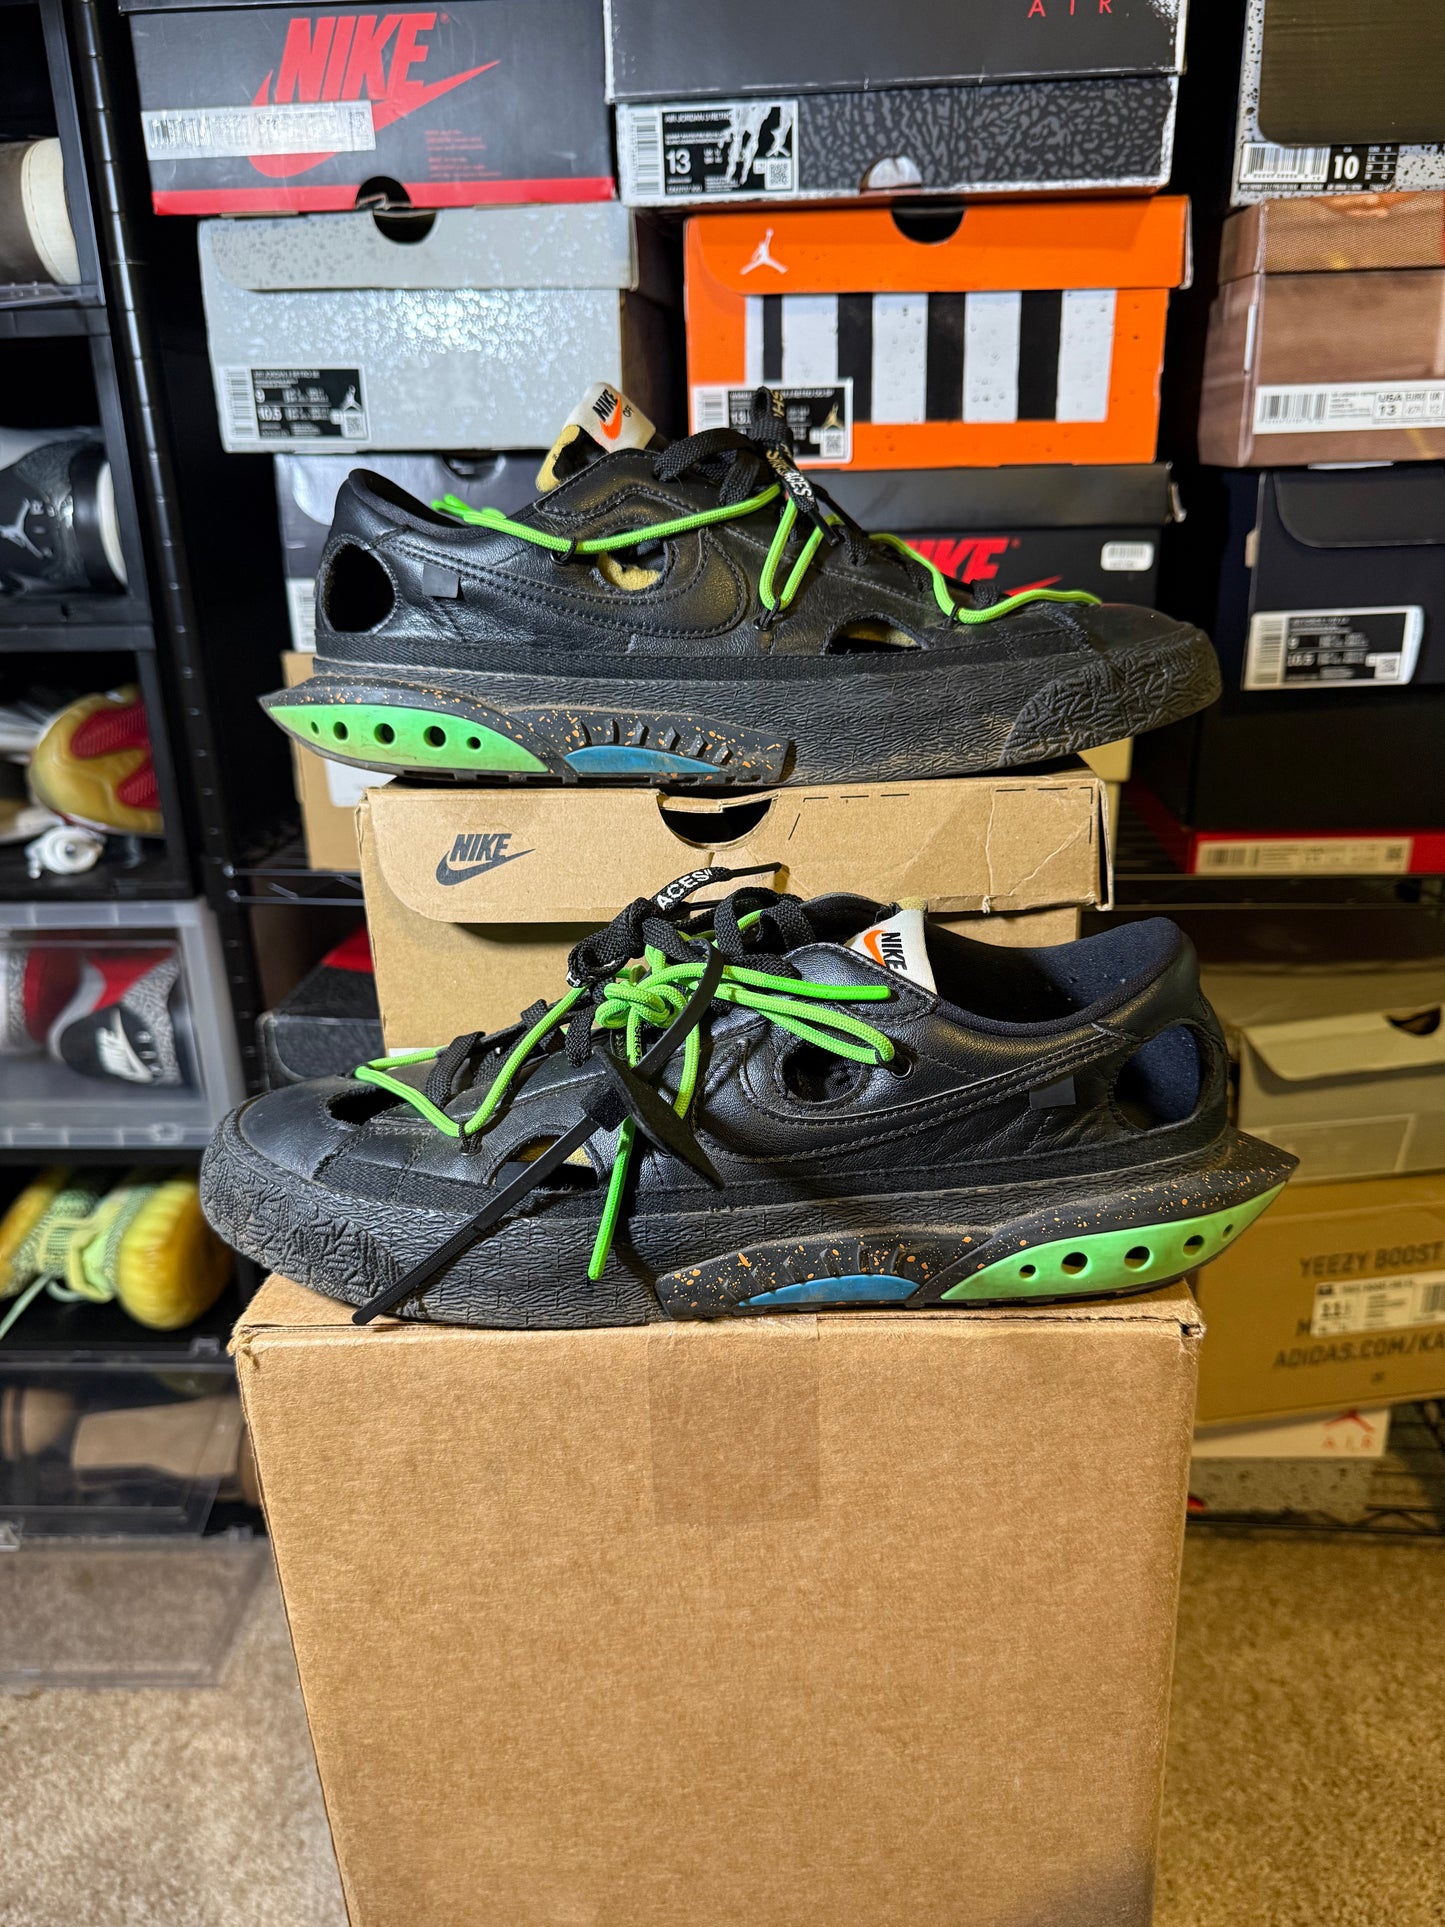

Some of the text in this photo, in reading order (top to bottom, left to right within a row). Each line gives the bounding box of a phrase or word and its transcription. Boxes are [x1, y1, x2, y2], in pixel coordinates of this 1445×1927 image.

[274, 12, 437, 104] NIKE
[666, 148, 691, 175] 13
[1334, 155, 1360, 180] 10
[592, 389, 618, 422] NIKE
[449, 833, 512, 862] NIKE
[881, 932, 908, 970] NIKE
[1300, 1240, 1443, 1278] YEEZY BOOST
